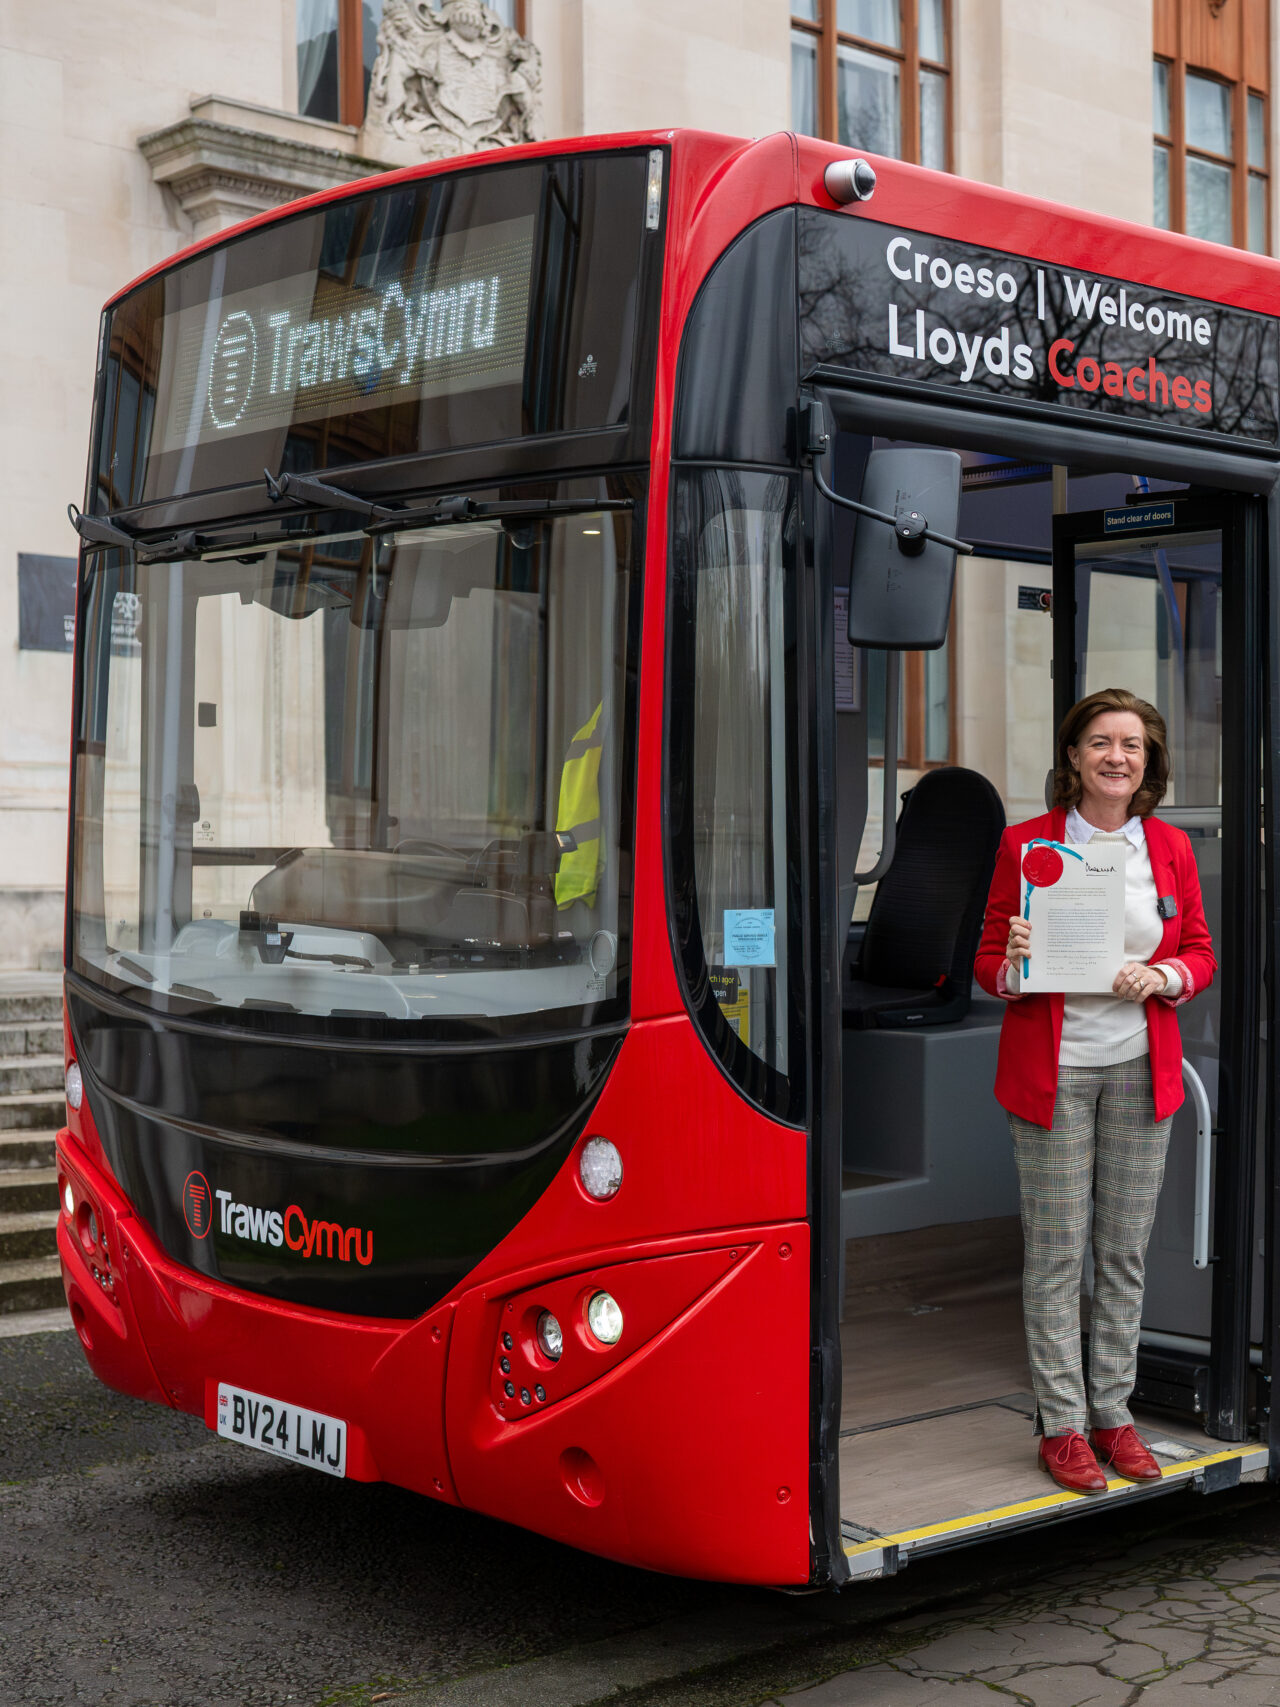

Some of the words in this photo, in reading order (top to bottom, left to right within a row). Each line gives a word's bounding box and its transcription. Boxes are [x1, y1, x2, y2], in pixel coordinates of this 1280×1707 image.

[268, 275, 499, 393] TrawsCymru
[886, 236, 1018, 303] Croeso
[1063, 275, 1212, 346] Welcome
[888, 303, 1034, 383] Lloyds
[1048, 338, 1213, 414] Coaches
[1106, 515, 1126, 526] Stand
[1126, 514, 1143, 524] clear
[1144, 512, 1151, 521] of
[1152, 511, 1172, 520] doors
[215, 1189, 374, 1266] TrawsCymru
[219, 1413, 227, 1426] UK
[232, 1394, 289, 1450] BV24
[296, 1414, 341, 1468] LMJ
